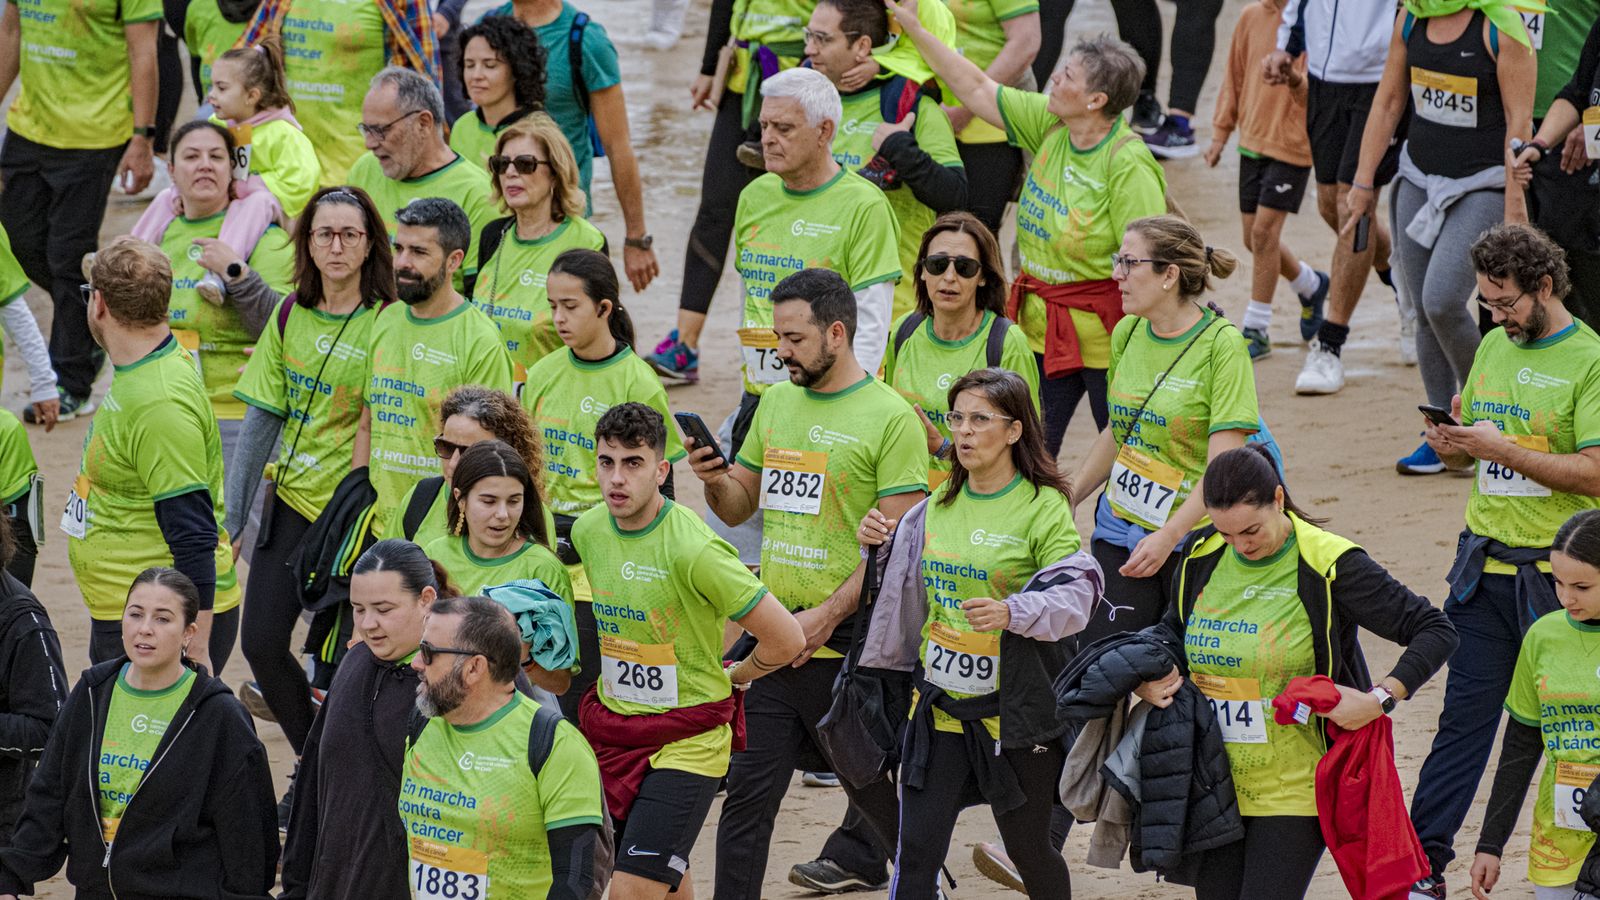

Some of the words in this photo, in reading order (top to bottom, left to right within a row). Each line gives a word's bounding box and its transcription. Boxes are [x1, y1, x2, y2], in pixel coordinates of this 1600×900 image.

[1422, 87, 1473, 113] 4845
[832, 151, 861, 165] rcha
[755, 253, 804, 270] marcha
[748, 286, 771, 299] cán
[767, 469, 821, 498] 2852
[1117, 468, 1174, 509] 4817
[772, 540, 828, 560] HYUNDAI
[929, 558, 988, 581] marcha
[594, 602, 646, 622] marcha
[1198, 617, 1258, 634] marcha
[931, 645, 993, 680] 2799
[1190, 650, 1242, 668] cáncer
[617, 660, 664, 691] 268
[1541, 703, 1557, 717] En
[1561, 703, 1600, 716] marc
[1542, 716, 1594, 735] contra
[1548, 735, 1560, 750] el
[1563, 734, 1600, 751] cánc
[101, 752, 149, 772] archa
[100, 789, 132, 806] ncer
[403, 778, 416, 795] En
[418, 785, 477, 809] marcha
[411, 820, 464, 843] cáncer
[415, 863, 480, 900] 1883
